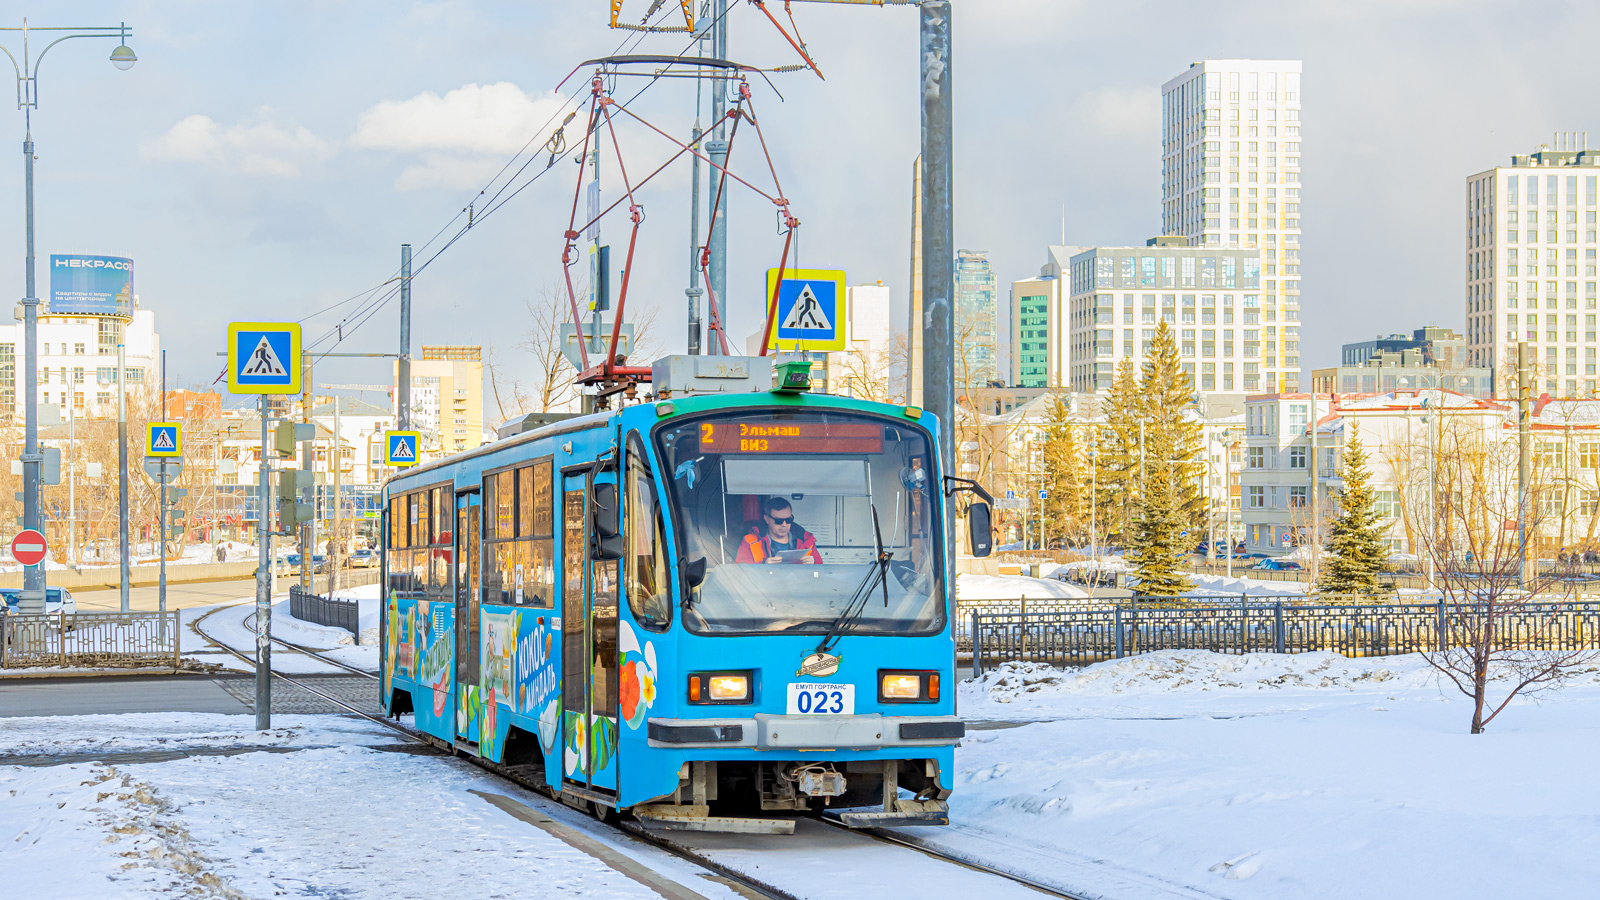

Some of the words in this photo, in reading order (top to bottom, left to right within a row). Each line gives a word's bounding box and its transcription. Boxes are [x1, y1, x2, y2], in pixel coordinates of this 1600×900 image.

[701, 423, 714, 443] 2
[739, 423, 800, 436] Эльмаш
[740, 439, 768, 451] ВИЗ
[518, 625, 546, 682] КОКОС
[526, 662, 556, 714] МИНДАЛЬ
[798, 691, 843, 714] 023
